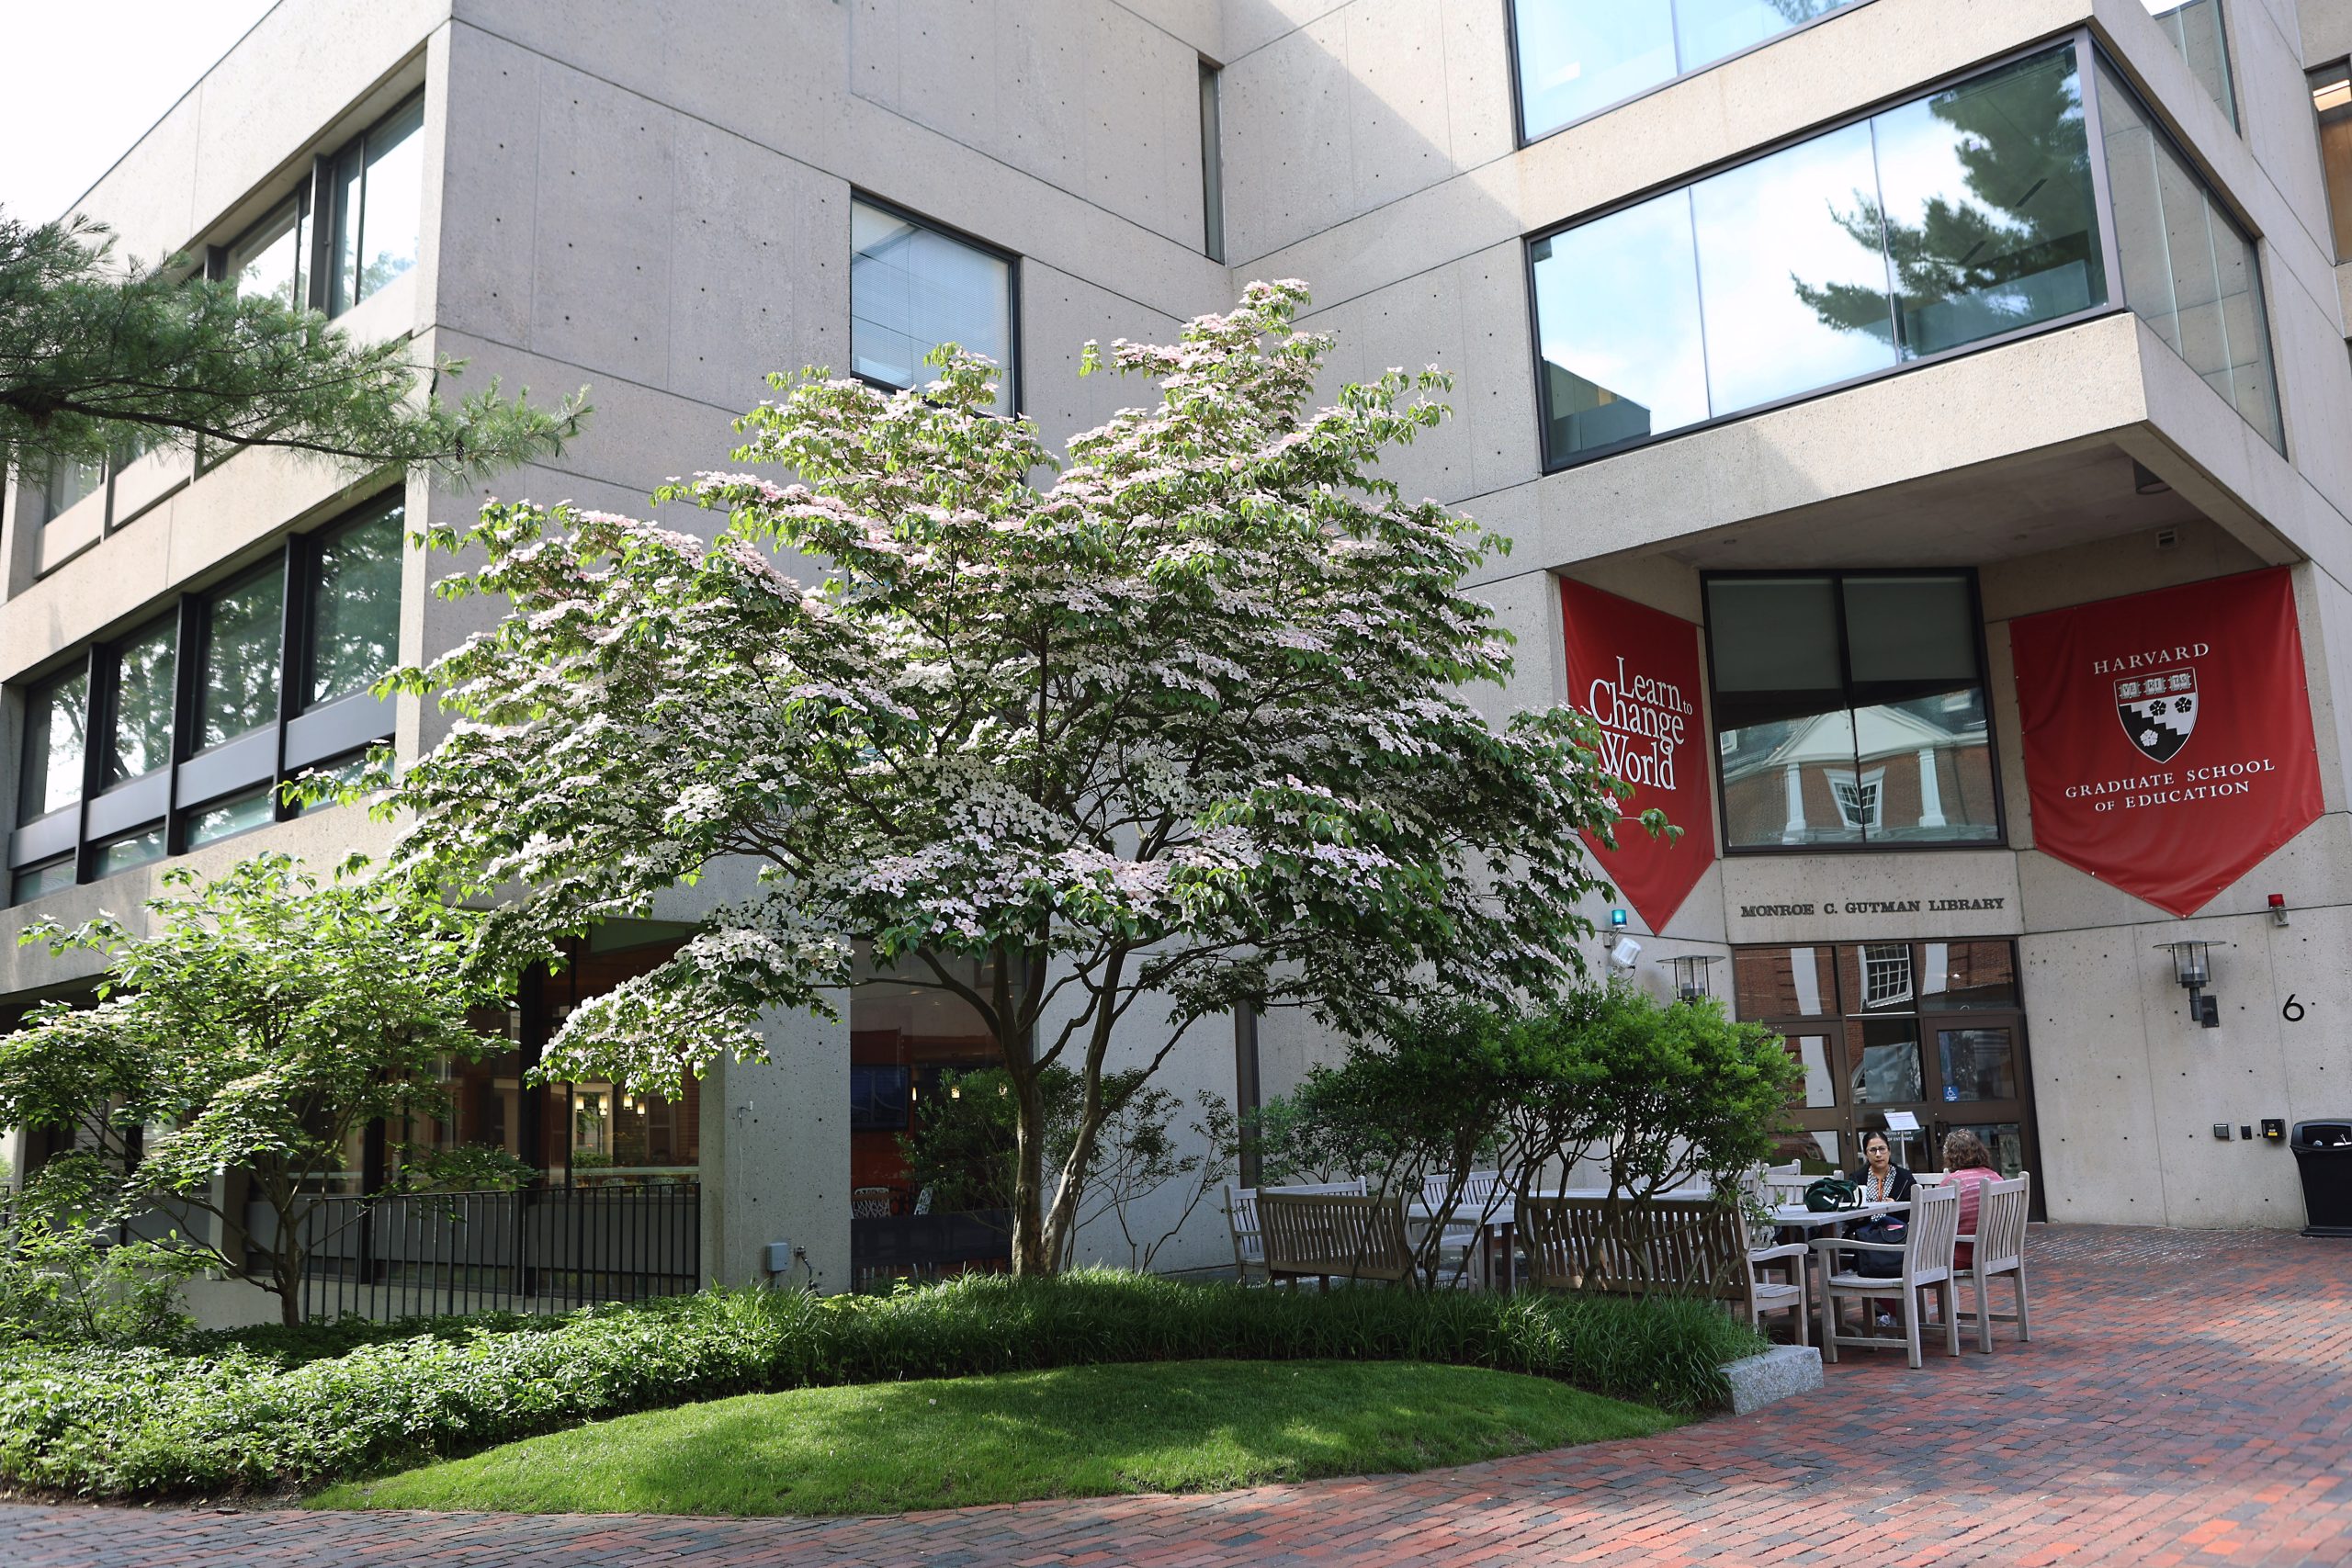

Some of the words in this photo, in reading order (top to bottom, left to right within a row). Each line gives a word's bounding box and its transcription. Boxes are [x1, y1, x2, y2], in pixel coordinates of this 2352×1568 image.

[2094, 643, 2211, 675] HARVARD
[1616, 655, 1682, 713] Learn
[1682, 700, 1693, 716] to
[2173, 675, 2187, 684] TAS
[1589, 678, 1685, 755] Change
[1598, 729, 1677, 791] World
[2065, 773, 2176, 798] GRADUATE
[2187, 758, 2276, 783] SCHOOL
[2095, 801, 2115, 812] OF
[2125, 781, 2250, 809] EDUCATION
[1741, 904, 1815, 918] MONROE
[1823, 903, 1838, 914] C.
[1845, 900, 1920, 914] GUTMAN
[1928, 897, 2005, 911] LIBRARY
[2283, 994, 2304, 1021] 6
